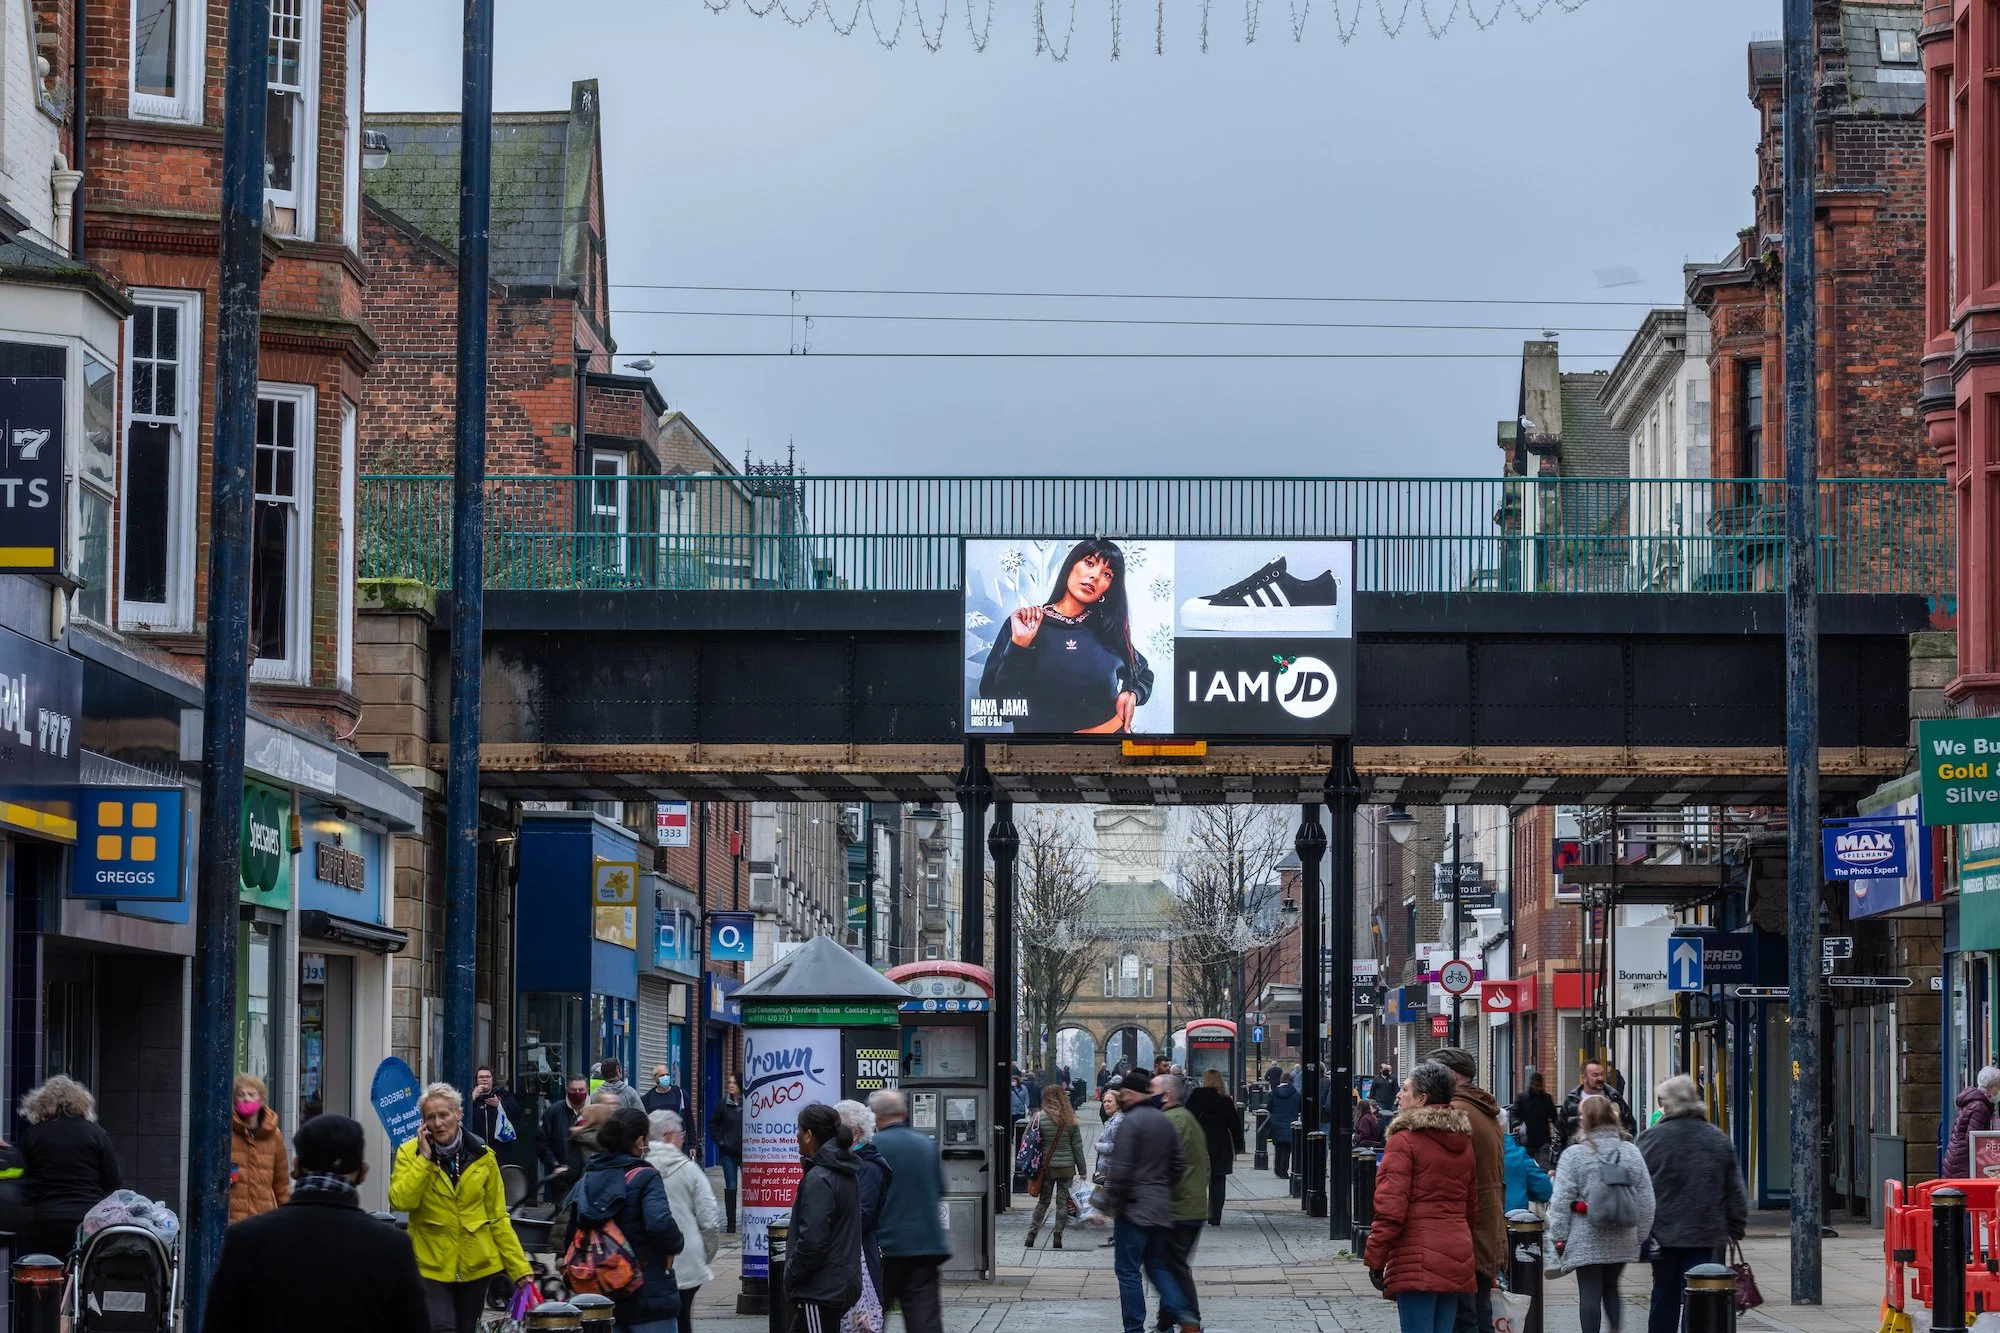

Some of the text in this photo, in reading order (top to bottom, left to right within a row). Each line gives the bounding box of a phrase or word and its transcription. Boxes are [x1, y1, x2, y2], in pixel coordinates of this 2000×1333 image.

[1188, 670, 1329, 703] I AM JD
[970, 699, 1029, 717] MAYA JAMA
[970, 716, 988, 727] HOST
[993, 716, 1003, 727] DJ
[38, 708, 72, 759] 777
[1932, 740, 1967, 757] We
[1938, 762, 1988, 780] Gold
[656, 814, 669, 826] T
[249, 812, 280, 858] Specsavers
[659, 828, 682, 838] 1333
[1836, 833, 1893, 851] MAX
[1842, 850, 1889, 859] SPIELMANN
[1833, 865, 1899, 876] The Photo Expert
[95, 870, 156, 884] GREGGS
[1460, 886, 1469, 894] TO
[1933, 978, 1942, 989] S
[790, 1006, 820, 1014] Wardens
[822, 1006, 841, 1014] Team
[844, 1006, 869, 1014] Contact
[767, 1014, 778, 1022] 420
[778, 1014, 793, 1022] 3713
[744, 1036, 826, 1088] Crown
[750, 1081, 804, 1118] BINGO
[744, 1123, 762, 1134] TYNE
[766, 1166, 786, 1175] great
[761, 1178, 780, 1187] great
[760, 1188, 772, 1202] TO
[773, 1188, 792, 1202] THE
